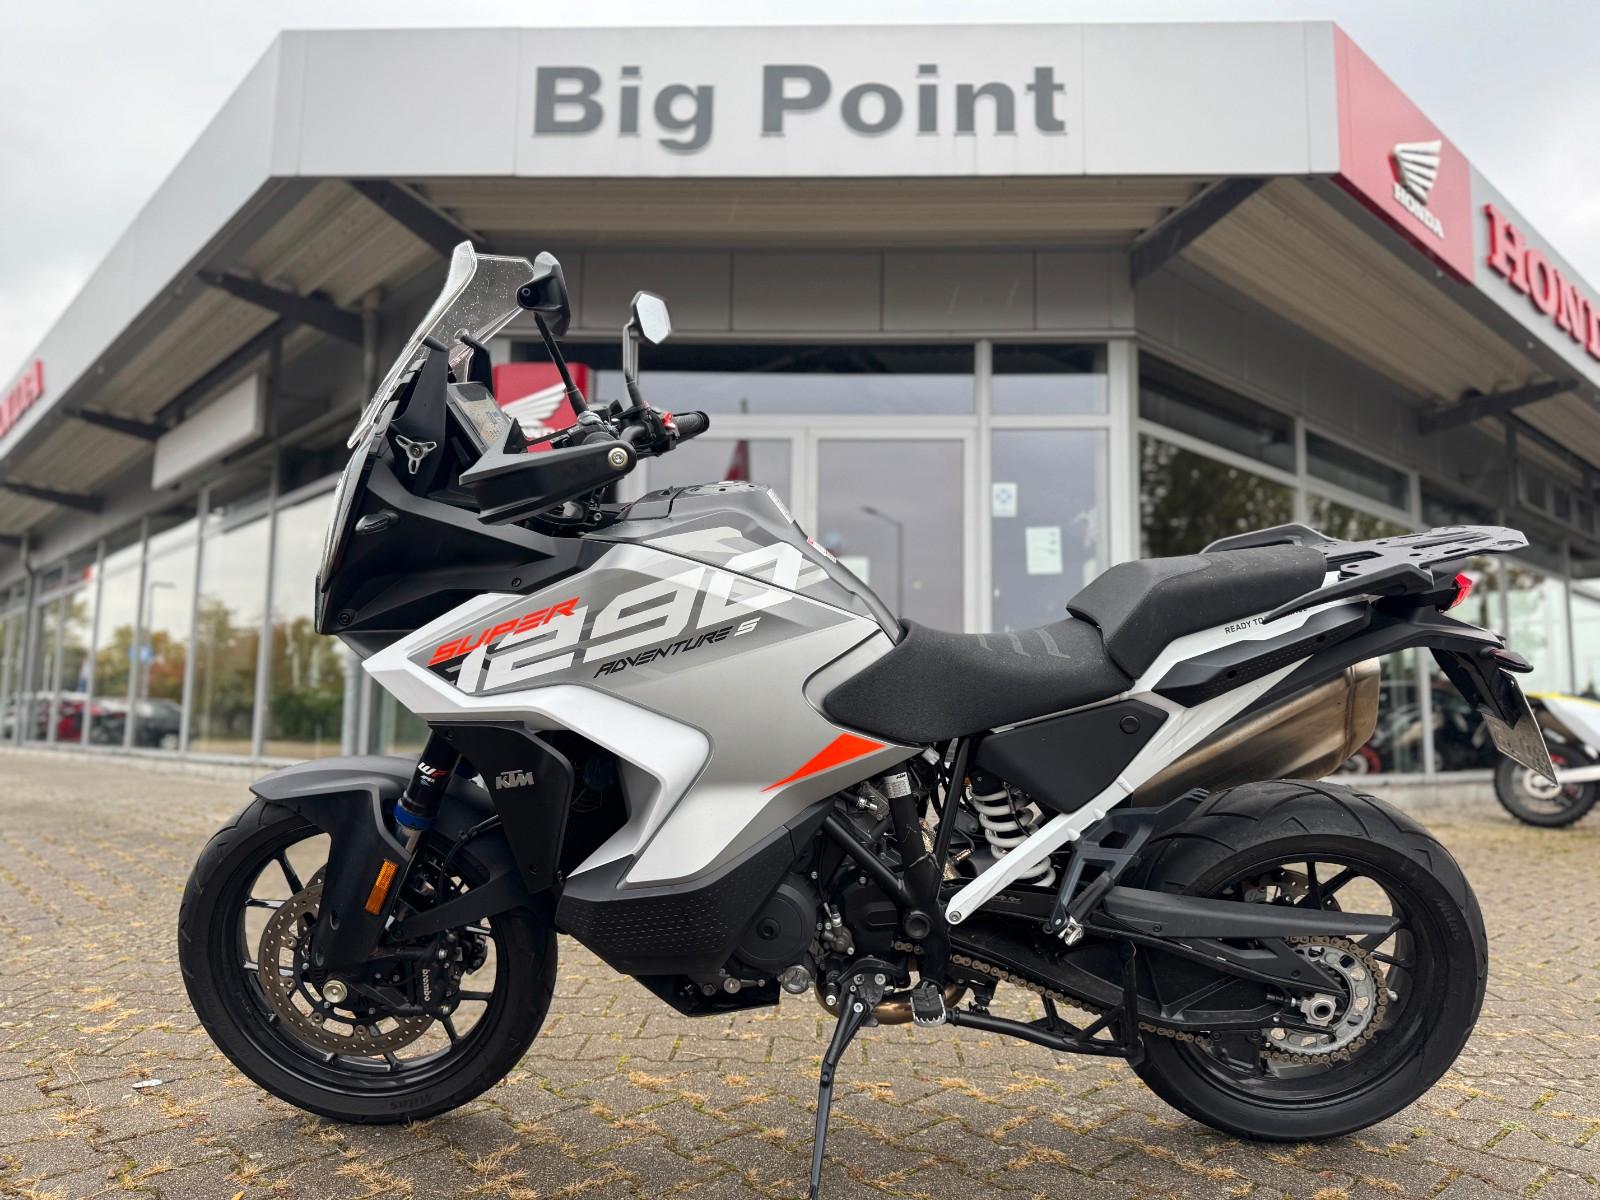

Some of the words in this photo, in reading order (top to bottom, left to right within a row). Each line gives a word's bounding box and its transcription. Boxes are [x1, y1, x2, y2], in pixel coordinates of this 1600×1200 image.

[532, 65, 715, 155] Big
[760, 62, 1068, 137] Point
[1392, 181, 1445, 240] HONDA
[426, 596, 580, 667] SUPER
[455, 541, 803, 693] 1290
[593, 625, 735, 679] ADVENTURE
[733, 616, 762, 637] S
[1224, 620, 1252, 634] READY
[495, 769, 535, 790] KTM
[422, 968, 432, 1002] brembo
